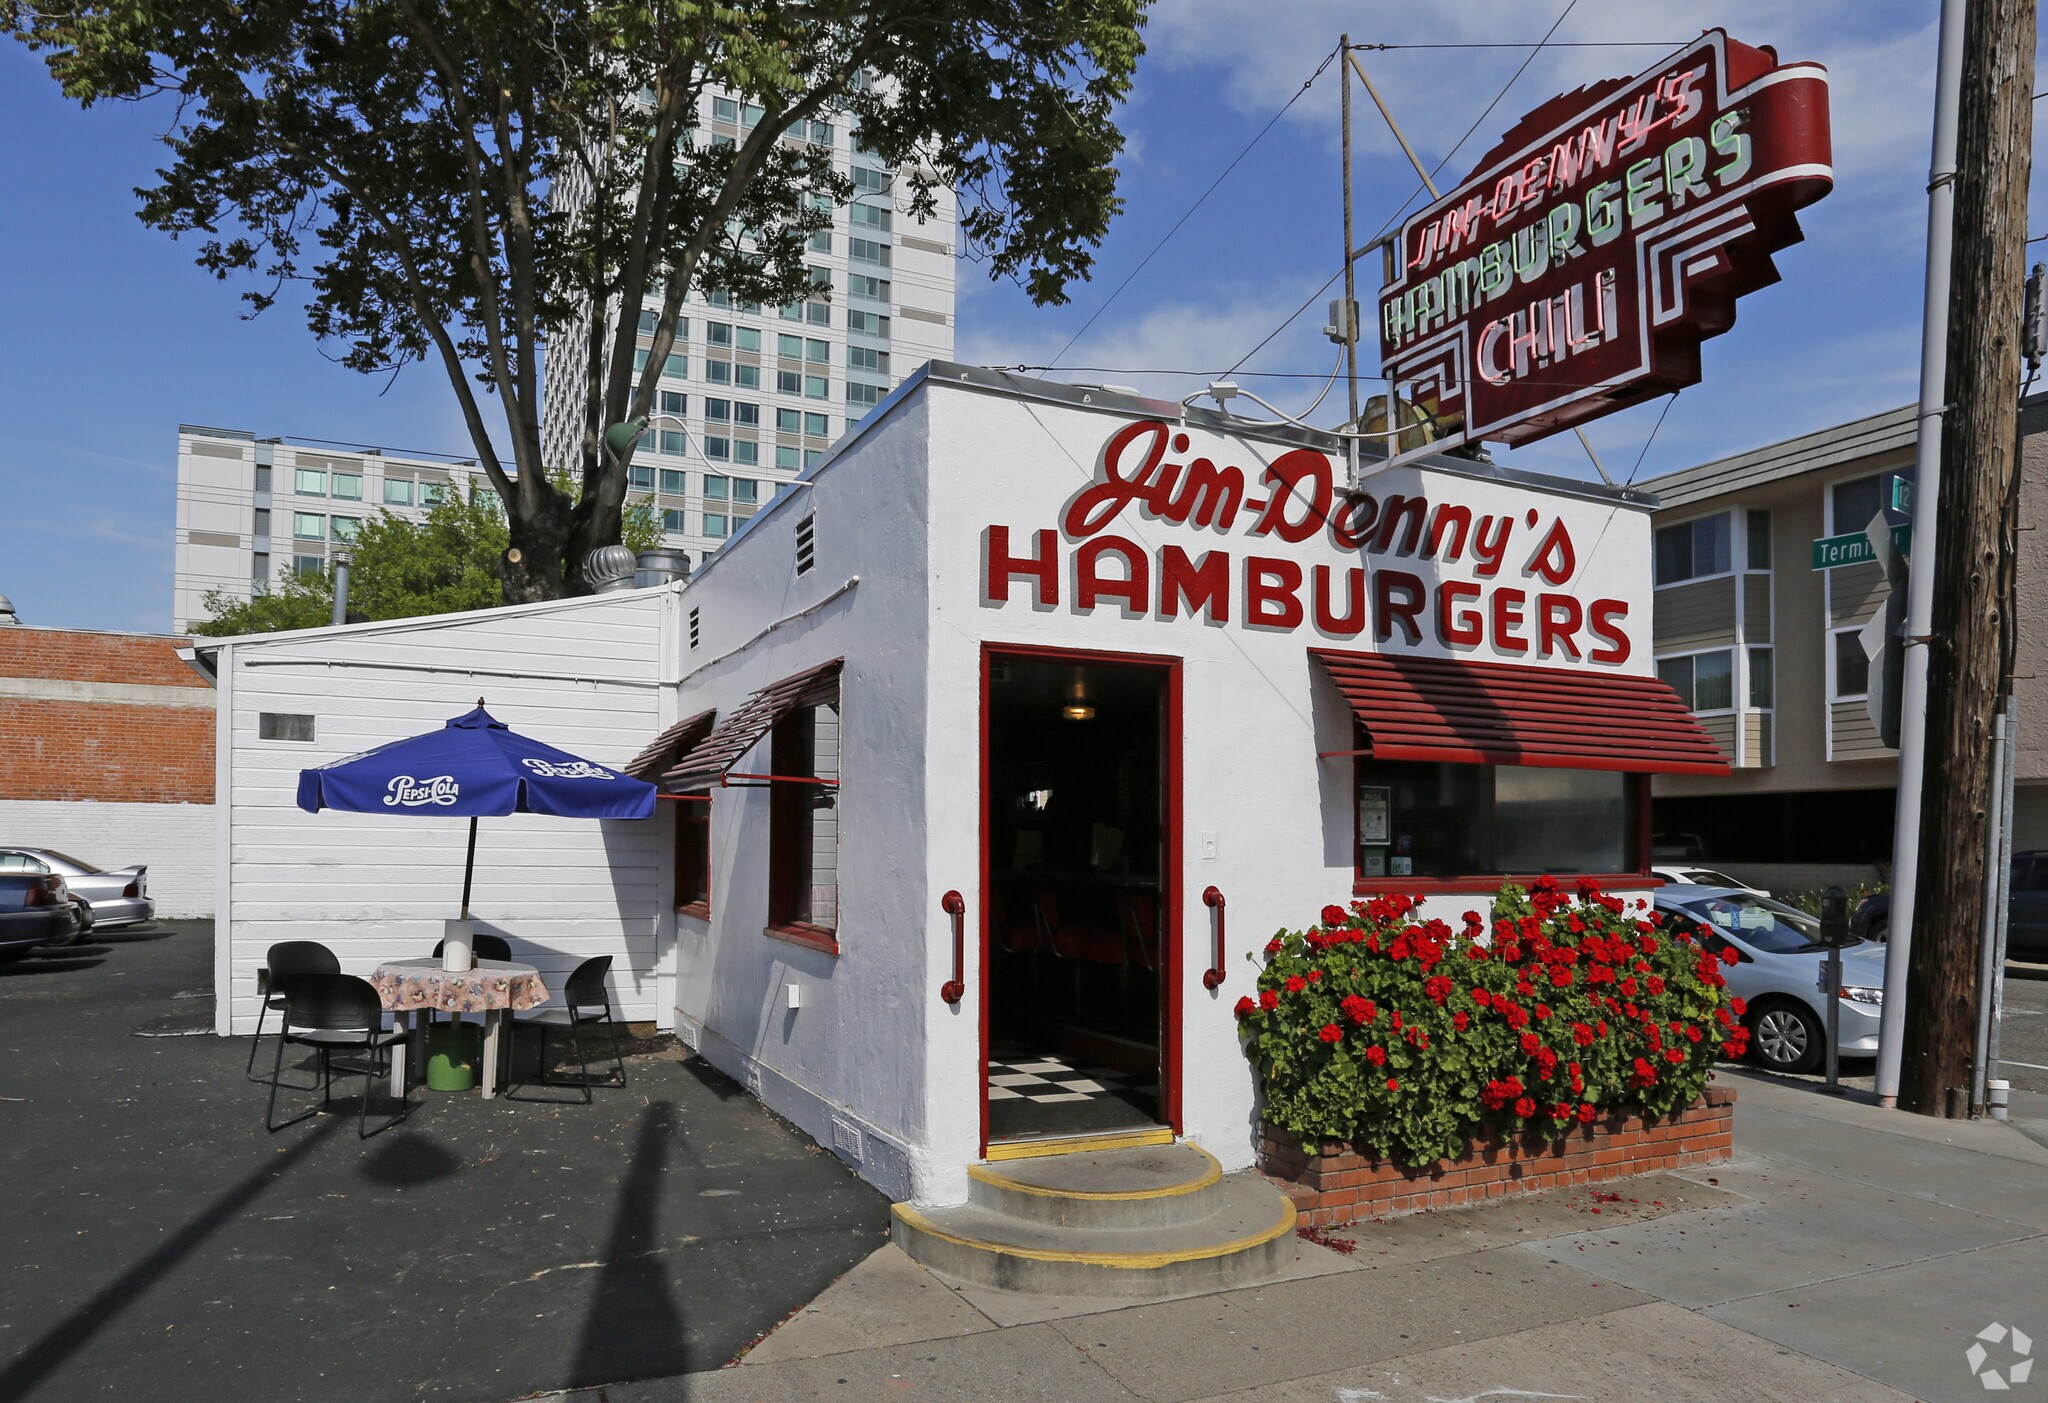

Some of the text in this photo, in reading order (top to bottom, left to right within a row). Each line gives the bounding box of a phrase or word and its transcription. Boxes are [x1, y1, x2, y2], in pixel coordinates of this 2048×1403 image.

[1384, 108, 1752, 351] HAMBURGERS
[1476, 267, 1618, 386] CHILI
[1062, 420, 1576, 588] Jim-Denny's
[980, 525, 1632, 666] HAMBURGERS
[1364, 793, 1383, 801] PASS
